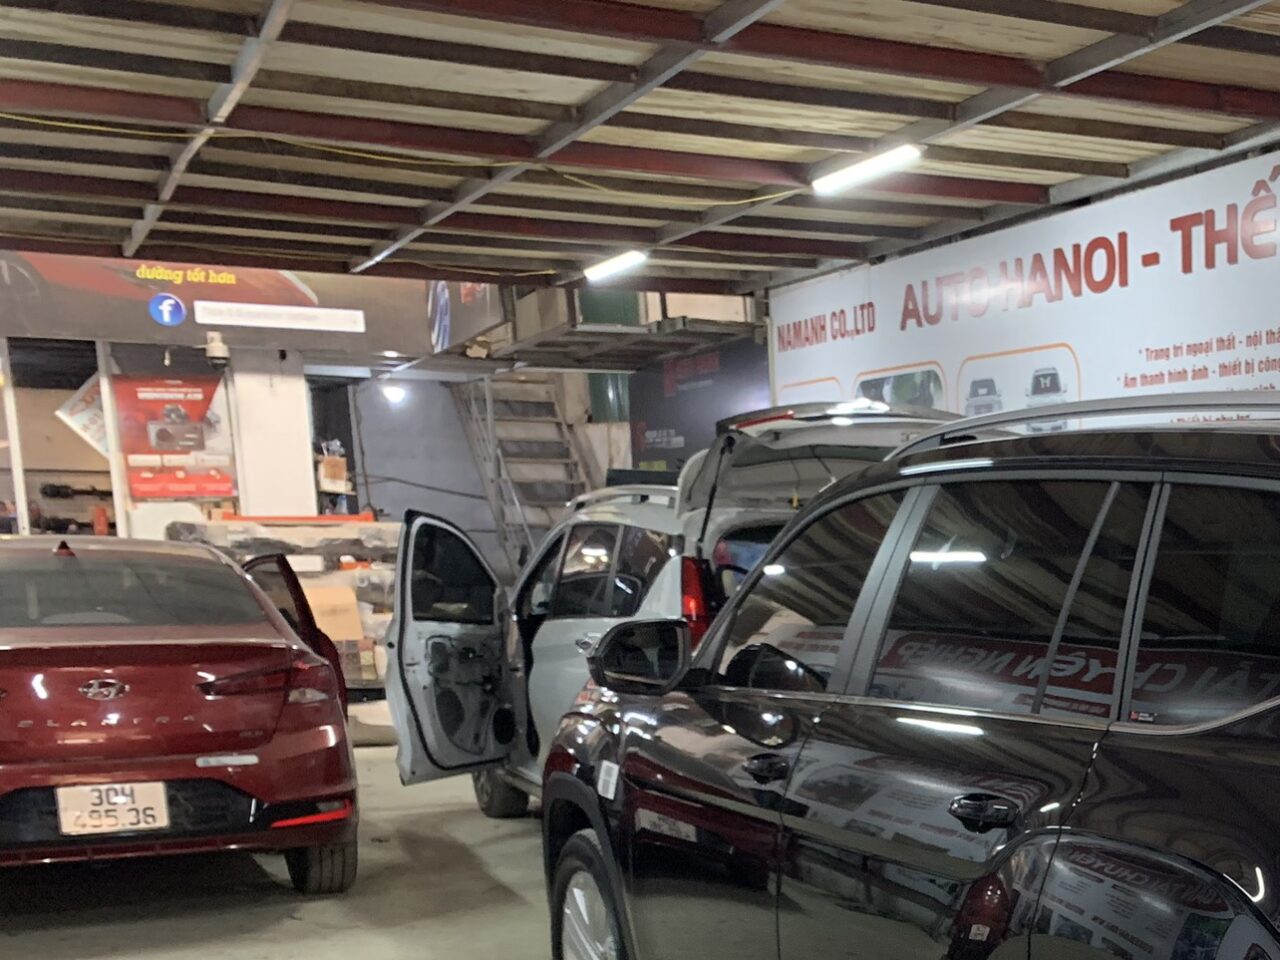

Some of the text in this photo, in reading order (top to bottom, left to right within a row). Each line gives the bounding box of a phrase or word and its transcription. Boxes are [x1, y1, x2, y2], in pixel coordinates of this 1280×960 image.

[900, 266, 990, 331] AUTO
[999, 231, 1129, 312] HANOI
[777, 313, 827, 352] NAMANH
[1145, 347, 1170, 361] Trang
[1186, 338, 1213, 357] ngoại
[1216, 331, 1236, 352] thất
[1246, 330, 1263, 350] nội
[1140, 371, 1166, 387] thanh
[1218, 357, 1242, 377] thiết
